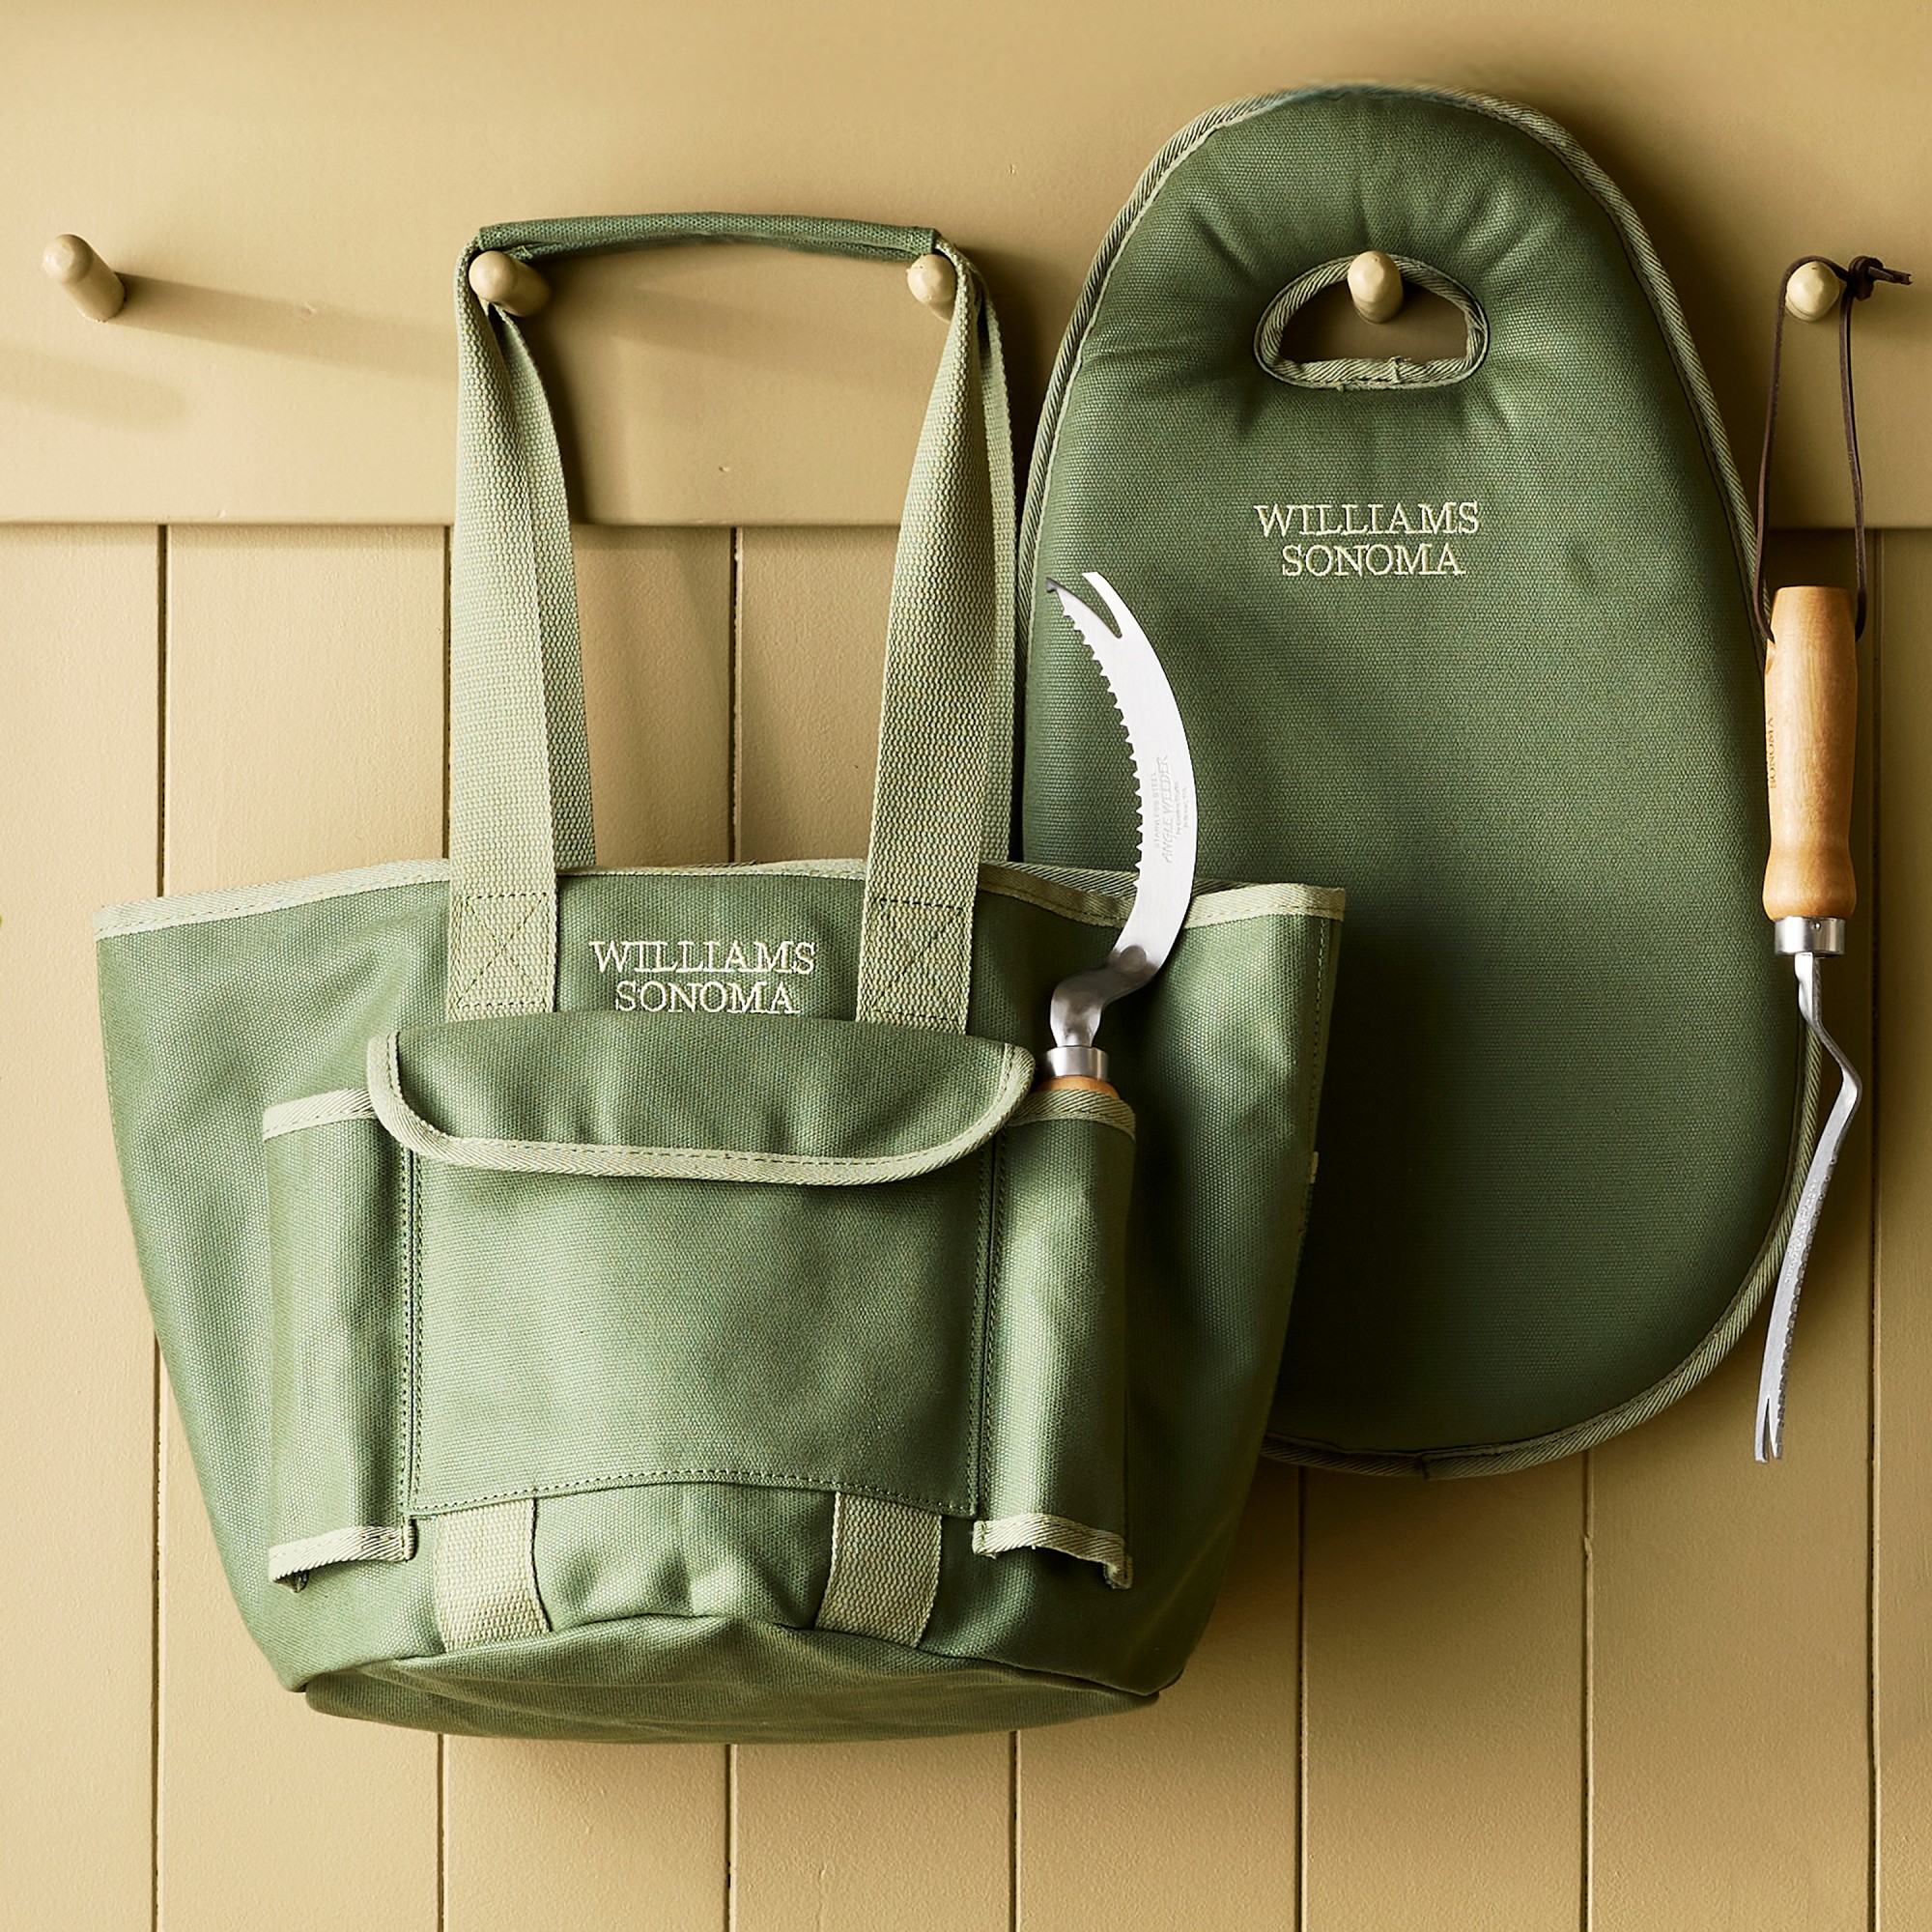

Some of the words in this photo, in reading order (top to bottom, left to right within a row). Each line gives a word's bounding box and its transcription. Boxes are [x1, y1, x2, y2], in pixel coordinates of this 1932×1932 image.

[1253, 500, 1480, 538] WILLIAMS
[1282, 542, 1467, 577] SONOMA
[1151, 772, 1159, 798] STEEL
[1156, 755, 1172, 813] WEEDER
[1162, 817, 1175, 863] ANGLE
[589, 940, 816, 975] WILLIAMS
[615, 980, 802, 1014] SONOMA
